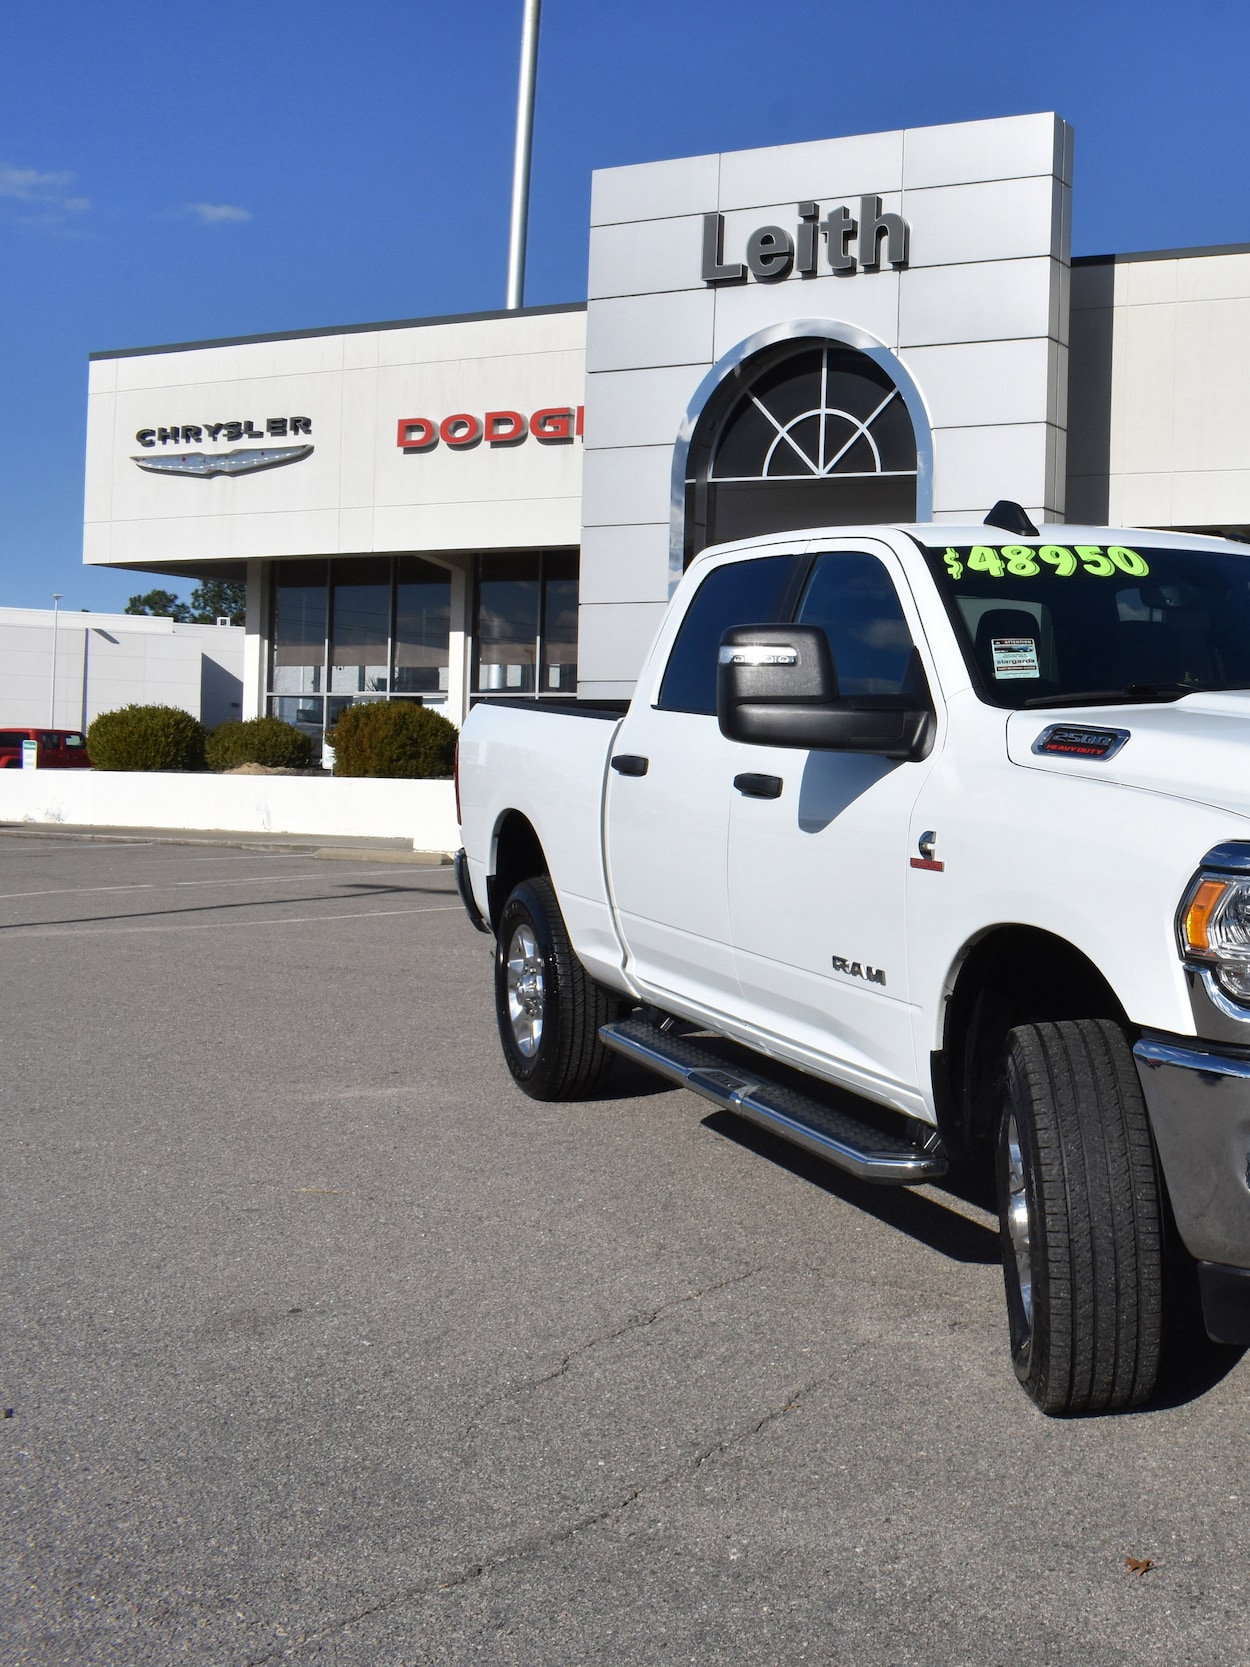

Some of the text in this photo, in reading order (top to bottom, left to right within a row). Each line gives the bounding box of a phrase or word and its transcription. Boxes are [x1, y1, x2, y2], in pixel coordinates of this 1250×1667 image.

[702, 194, 909, 285] Leith
[136, 416, 312, 447] CHRYSLER
[397, 406, 584, 450] DODG
[943, 545, 1149, 580] $48950
[1045, 743, 1104, 756] HEAVY DUTY
[1052, 731, 1111, 746] 2500
[832, 955, 886, 987] RAM
